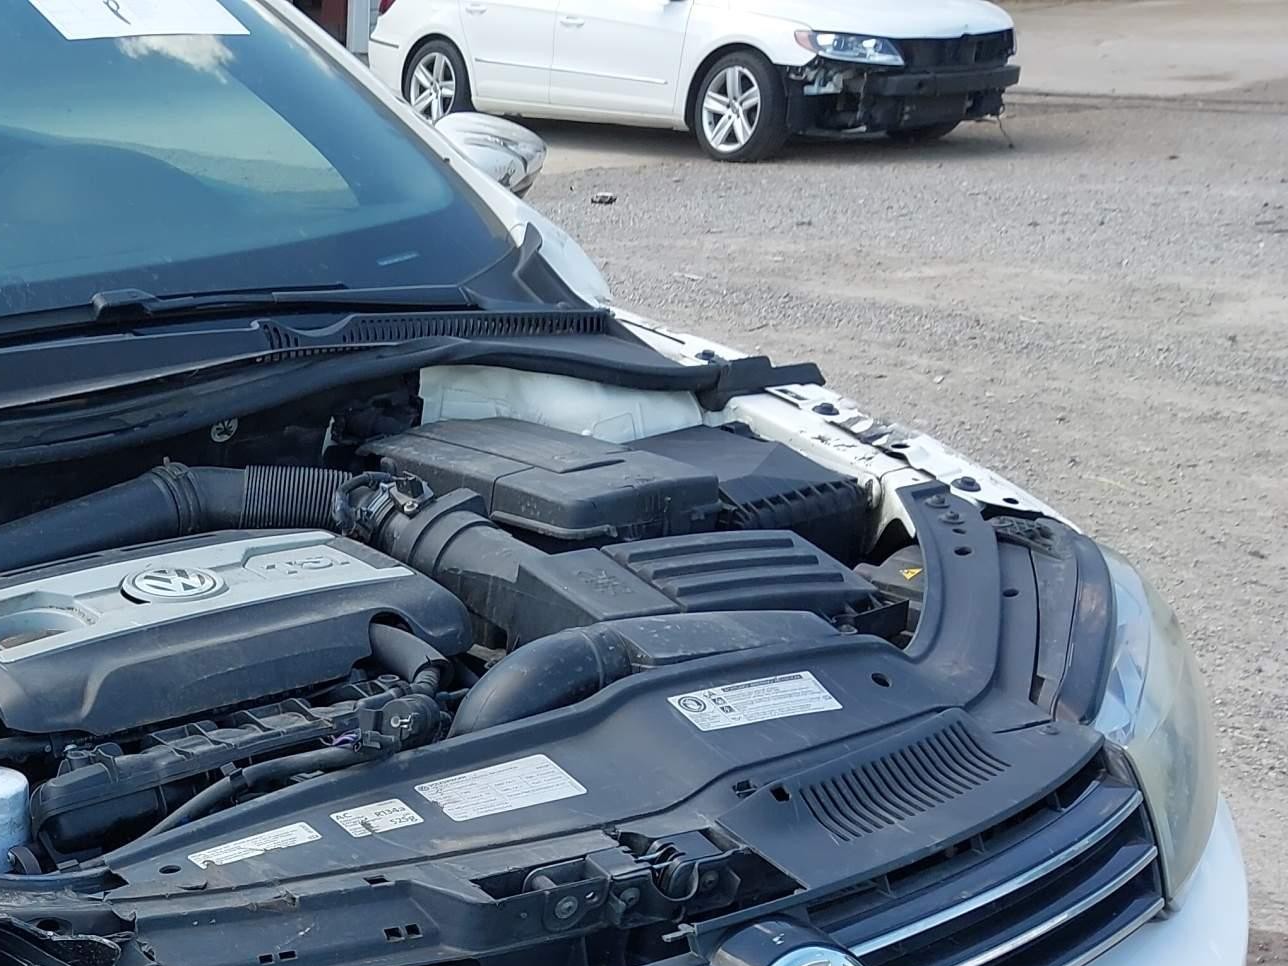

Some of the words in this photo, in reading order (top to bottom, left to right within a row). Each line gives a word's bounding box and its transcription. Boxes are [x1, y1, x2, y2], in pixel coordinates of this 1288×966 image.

[134, 567, 217, 598] VW
[335, 812, 353, 821] AC
[374, 807, 407, 818] R134a
